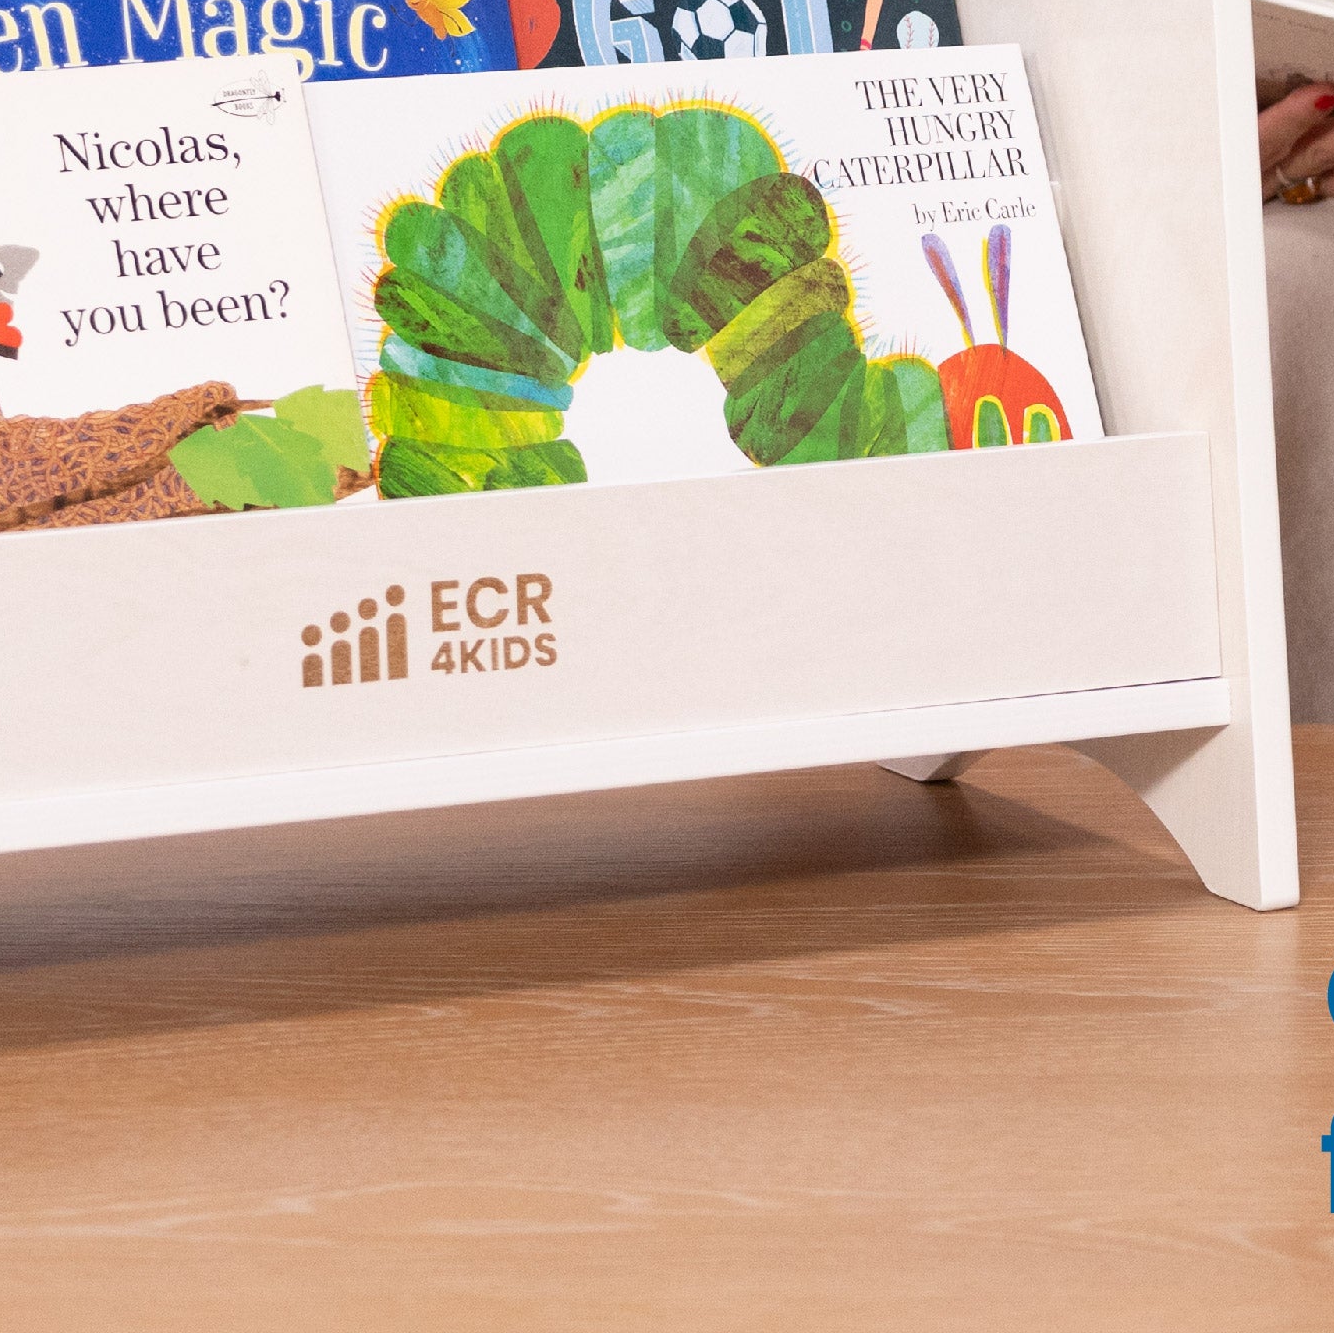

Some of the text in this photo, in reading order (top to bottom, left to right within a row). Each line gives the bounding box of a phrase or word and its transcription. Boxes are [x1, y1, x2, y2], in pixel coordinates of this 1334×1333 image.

[855, 72, 1009, 111] THE VERY
[884, 109, 1016, 146] HUNGRY
[53, 127, 241, 174] Nicolas,
[812, 147, 1030, 189] CATERPILLAR
[85, 183, 230, 225] where
[913, 197, 1037, 226] by Eric Carle
[114, 240, 222, 278] have
[60, 279, 292, 348] you been?
[430, 573, 553, 633] ECR
[430, 633, 558, 675] 4KIDS
